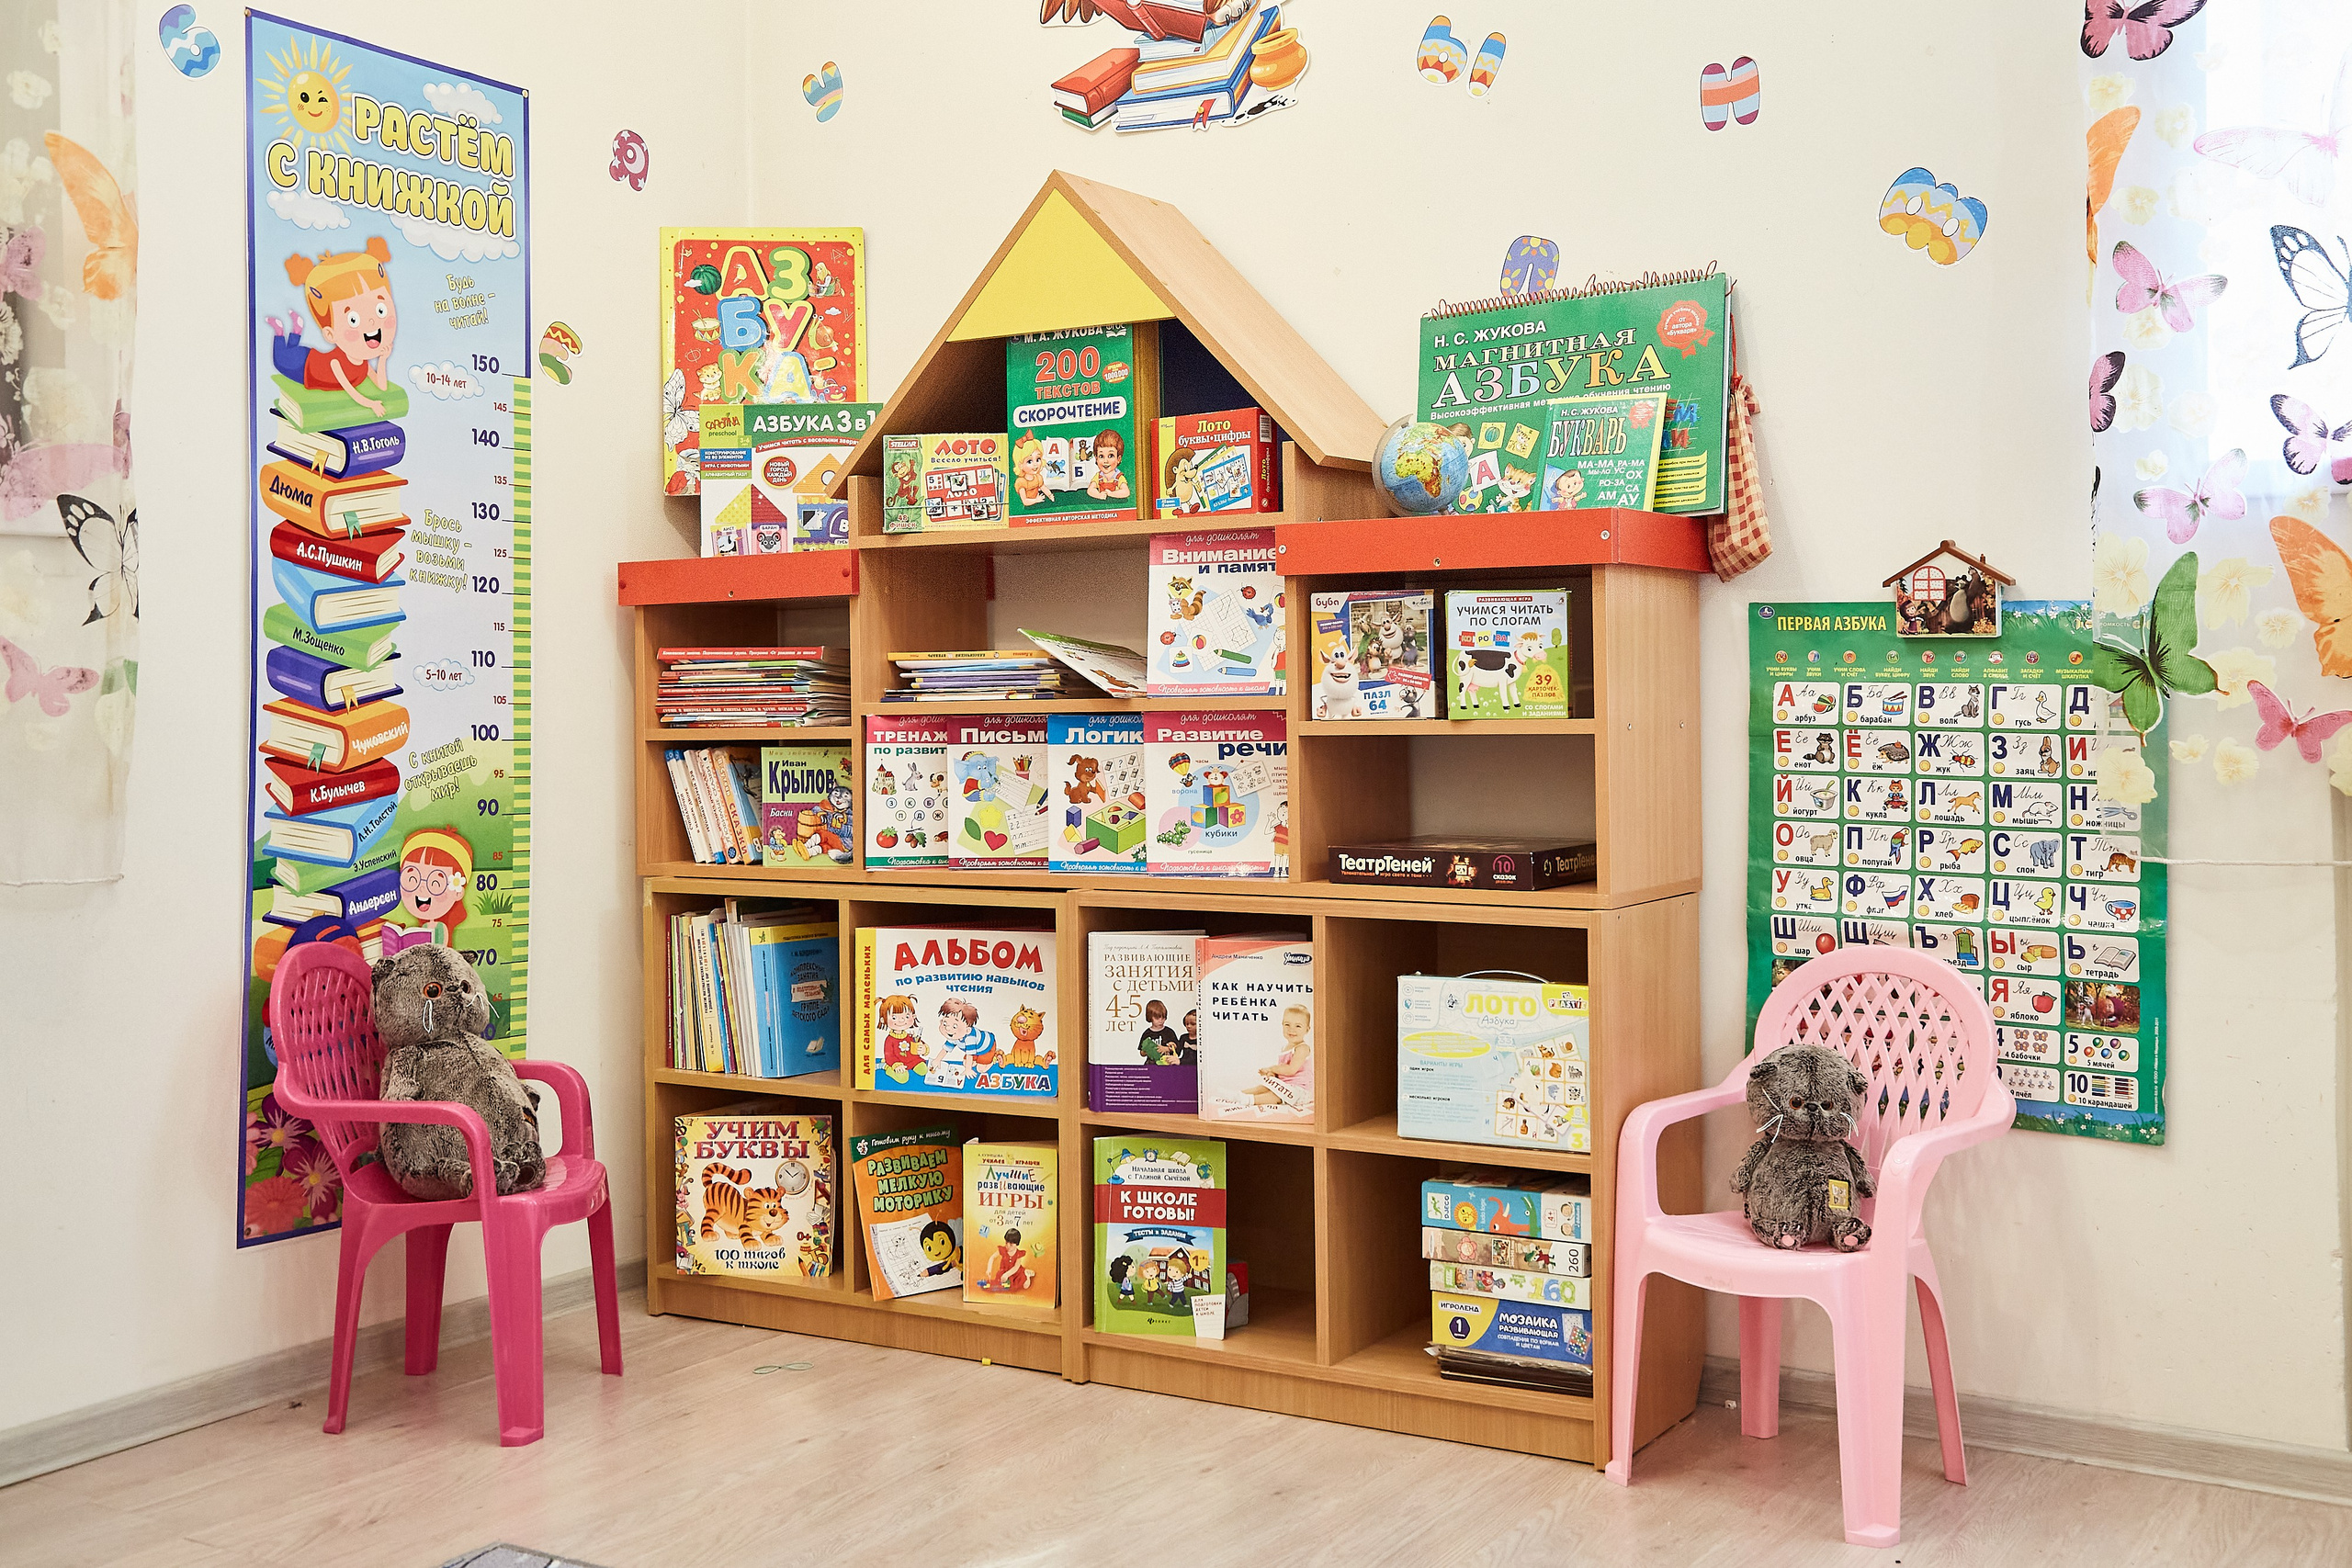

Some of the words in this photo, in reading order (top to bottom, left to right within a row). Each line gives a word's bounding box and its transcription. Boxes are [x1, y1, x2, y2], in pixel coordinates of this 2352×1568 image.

[355, 96, 514, 176] РАСТЁМ
[268, 143, 298, 187] С
[308, 152, 514, 237] КНИЖКОЙ
[446, 274, 475, 291] Будь
[435, 299, 449, 312] на
[452, 293, 485, 310] волне
[449, 312, 489, 329] читай!
[1475, 321, 1546, 343] ЖУКОВА
[1433, 329, 1636, 372] МАГНИТНАЯ
[472, 355, 499, 373] 150
[1035, 345, 1101, 382] 200
[454, 378, 467, 389] лет
[1432, 344, 1671, 409] АЗБУКА
[1035, 381, 1101, 400] ТЕКСТОВ
[494, 402, 507, 412] 145
[1019, 401, 1120, 423] СКОРОЧТЕНИЕ
[1430, 402, 1531, 421] Высокоэффективная
[1581, 406, 1618, 415] ЖУКОВА
[753, 415, 834, 432] АЗБУКА
[837, 411, 852, 433] 3
[1197, 421, 1231, 433] Лото
[353, 436, 399, 454] Н.В.Гоголь
[472, 430, 499, 447] 140
[1547, 417, 1627, 457] БУКВАРЬ
[934, 439, 996, 457] ЛОТО
[1577, 460, 1614, 468] МА-МА
[494, 476, 507, 485] 135
[269, 476, 312, 507] Дюма
[472, 503, 499, 520] 130
[424, 509, 461, 532] Брось
[1186, 536, 1204, 546] для
[1206, 533, 1259, 546] дошколят
[297, 542, 362, 571] А.С.Пушкин
[416, 550, 464, 570] возьми
[410, 569, 467, 593] книжку!
[472, 577, 499, 593] 120
[1457, 605, 1506, 616] УЧИМСЯ
[1510, 604, 1554, 615] ЧИТАТЬ
[1470, 616, 1488, 626] ПО
[1492, 615, 1541, 626] СЛОГАМ
[1778, 616, 1830, 631] ПЕРВАЯ
[1834, 616, 1886, 631] АЗБУКА
[293, 626, 345, 656] М.Зощенко
[472, 651, 495, 667] 110
[1535, 674, 1552, 685] 39
[493, 696, 506, 705] 105
[1363, 690, 1390, 700] ПАЗЛ
[1369, 700, 1386, 711] 64
[1860, 716, 1892, 724] барабан
[352, 722, 408, 753] Чуковский
[471, 725, 498, 740] 100
[1158, 728, 1263, 741] Развитие
[769, 761, 835, 801] Крылов
[311, 780, 365, 802] К.Булычев
[477, 800, 498, 816] 90
[770, 807, 793, 817] Басни
[1793, 807, 1817, 816] йогурт
[358, 801, 397, 842] Л.Н.Толстой
[1934, 814, 1964, 822] лошадь
[1205, 829, 1238, 838] кубики
[353, 849, 397, 873] Э.Успенский
[1339, 854, 1432, 876] ТеатрТеней
[476, 874, 497, 891] 80
[348, 890, 396, 914] Андерсен
[894, 938, 1043, 973] АЛЬБОМ
[1105, 965, 1193, 978] занятия
[2086, 969, 2119, 978] тетрадь
[896, 977, 912, 987] по
[916, 974, 982, 986] развитию
[986, 974, 1045, 991] навыков
[946, 984, 993, 993] чтения
[1127, 979, 1193, 993] детьми
[1212, 982, 1238, 991] КАК
[1247, 983, 1313, 993] НАУЧИТЬ
[1212, 996, 1277, 1007] РЕБЁНКА
[1464, 993, 1537, 1017] ЛОТО
[1213, 1012, 1269, 1021] ЧИТАТЬ
[1481, 1014, 1514, 1026] Азбука
[1105, 1020, 1136, 1032] лет
[2093, 1061, 2114, 1069] мячей
[977, 1073, 1050, 1090] АЗБУКА
[2088, 1099, 2132, 1109] карандашей
[704, 1121, 799, 1139] УЧИМ
[871, 1136, 899, 1146] Готовим
[902, 1135, 917, 1144] руку
[695, 1141, 809, 1159] БУКВЫ
[867, 1149, 947, 1177] РАЗВИВАЕМ
[877, 1170, 944, 1194] МЕЛКУЮ
[874, 1185, 953, 1213] МОТОРИКУ
[978, 1192, 1044, 1209] ИГРЫ
[1120, 1190, 1130, 1203] К
[1137, 1191, 1197, 1206] ШКОЛЕ
[1124, 1206, 1194, 1221] ГОТОВЫ!
[715, 1249, 740, 1260] 100
[744, 1247, 786, 1259] шагов
[1569, 1249, 1579, 1272] 260
[1441, 1303, 1479, 1313] ИГРОЛЕНД
[1499, 1313, 1557, 1329] МОЗАИКА
[1499, 1325, 1558, 1338] РАЗВИВАЮЩАЯ
